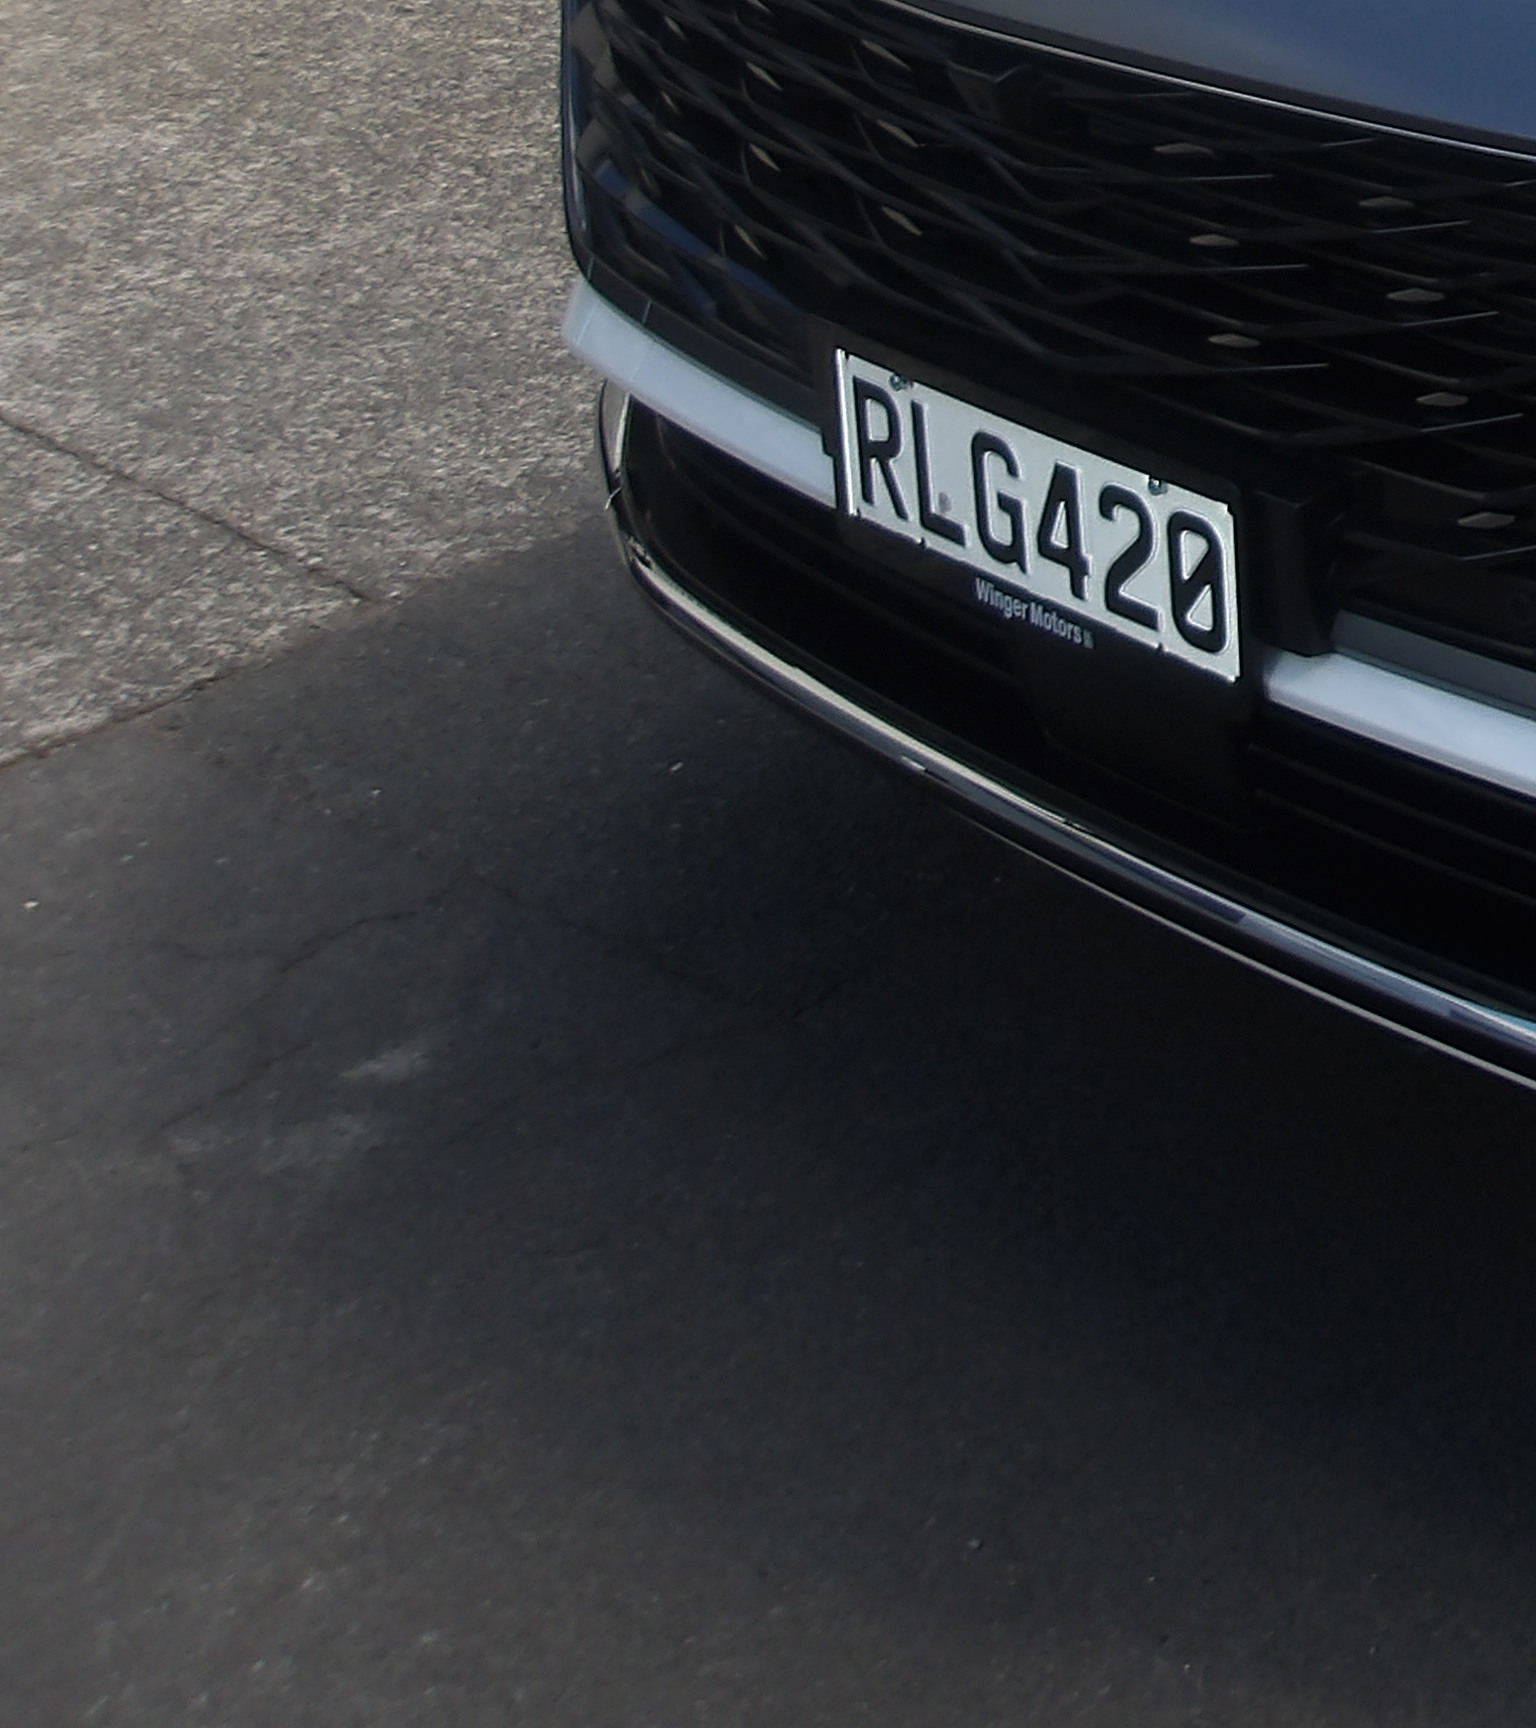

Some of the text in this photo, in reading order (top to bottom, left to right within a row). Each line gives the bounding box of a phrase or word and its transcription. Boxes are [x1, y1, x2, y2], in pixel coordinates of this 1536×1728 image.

[851, 374, 1231, 655] RLG420
[975, 576, 1029, 621] Winger
[1030, 601, 1083, 645] Motors
